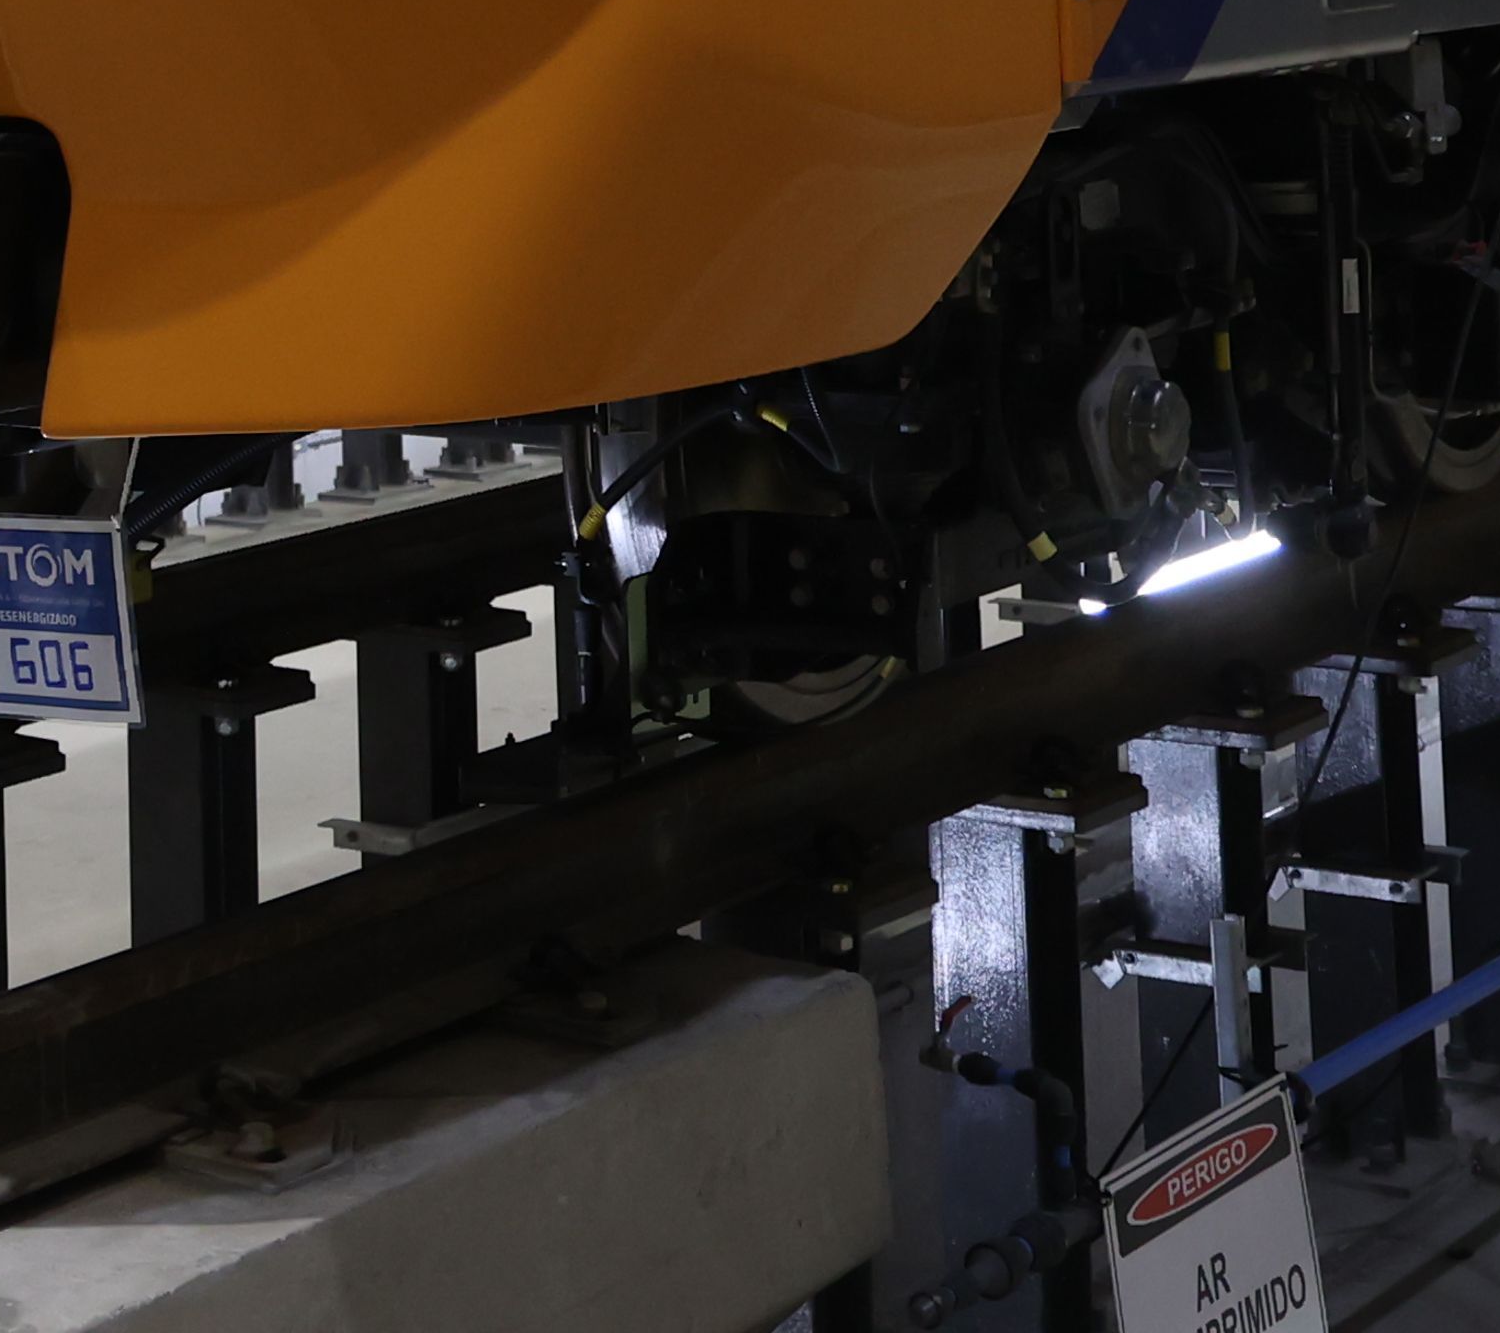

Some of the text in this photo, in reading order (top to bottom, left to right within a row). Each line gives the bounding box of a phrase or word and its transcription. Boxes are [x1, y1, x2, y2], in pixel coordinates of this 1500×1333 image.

[10, 637, 94, 692] 606
[1167, 1139, 1247, 1206] PERIGO
[1197, 1251, 1231, 1312] AR
